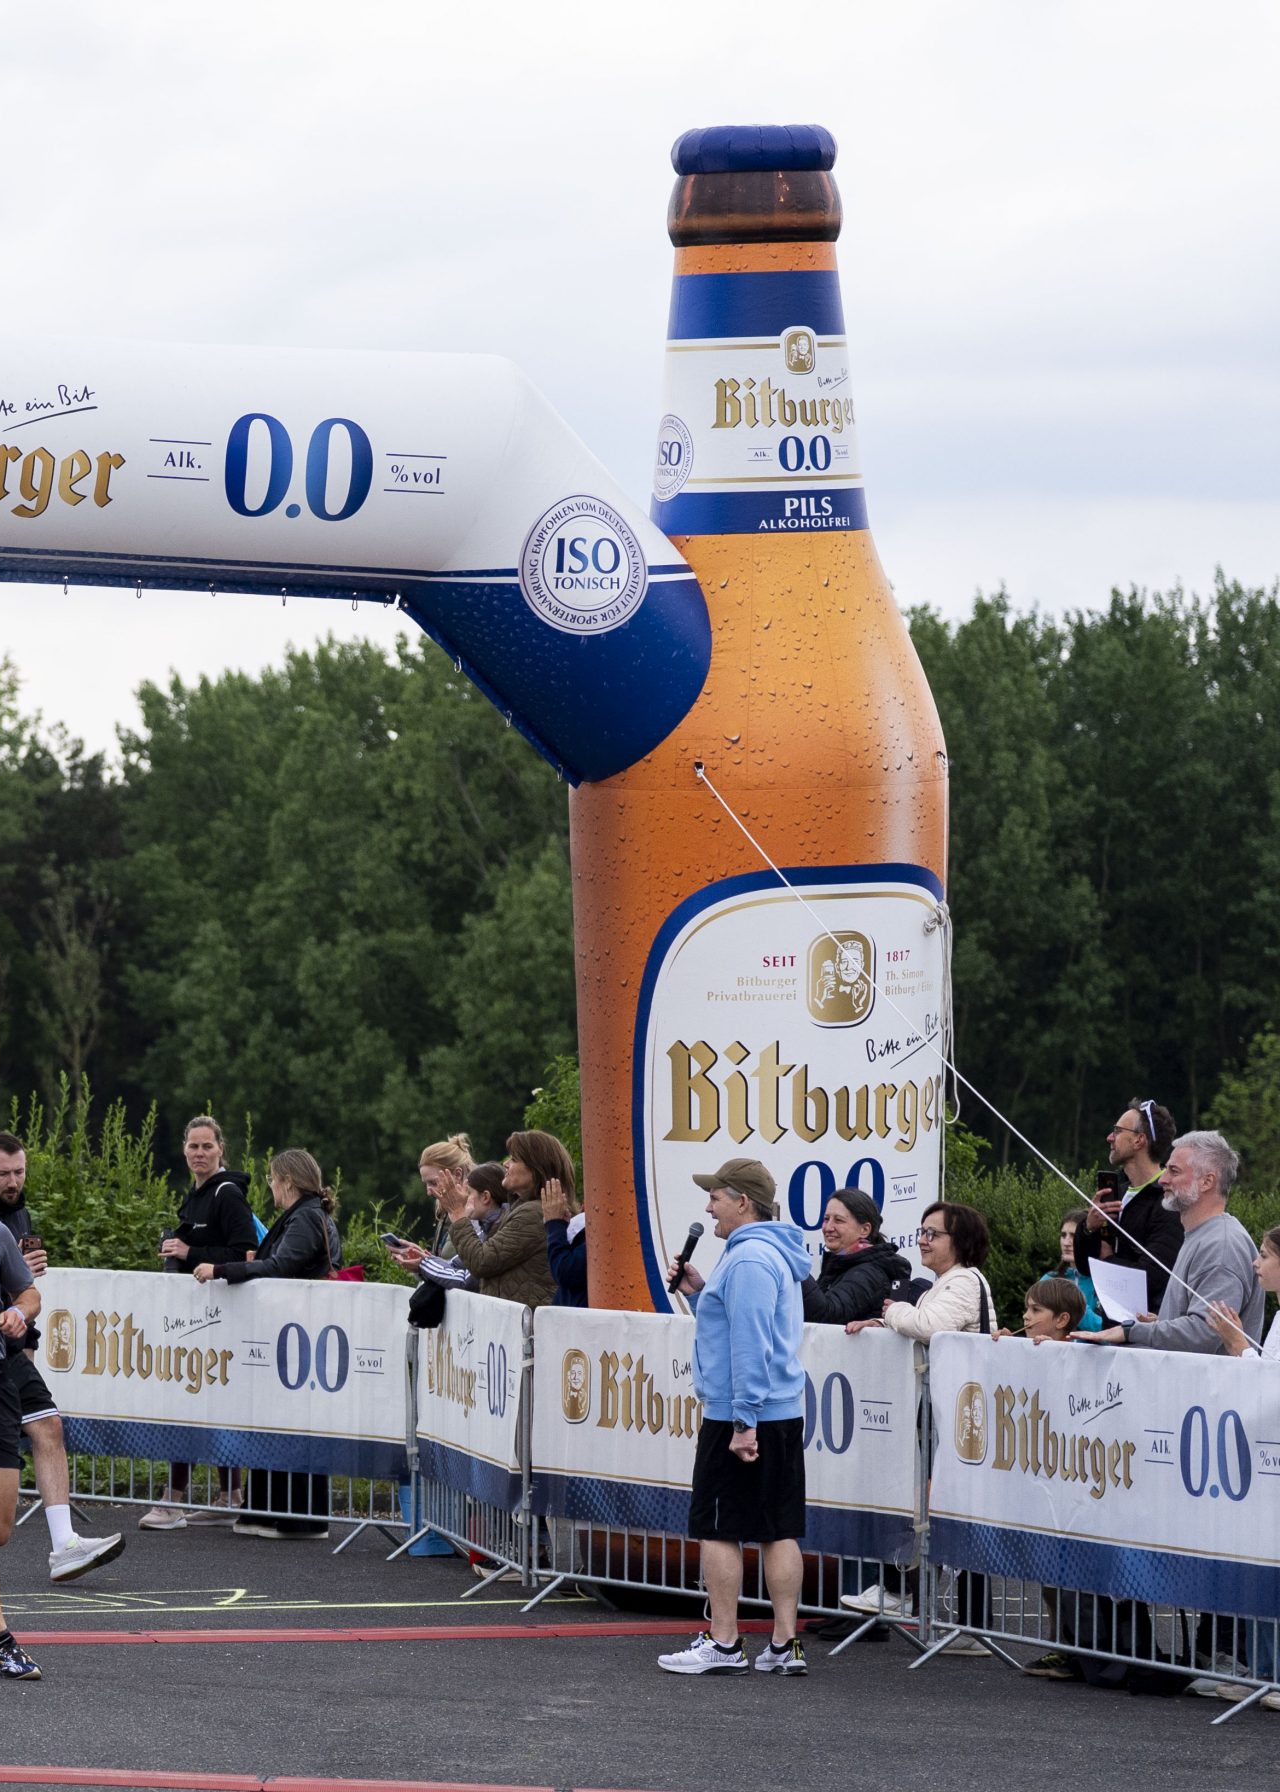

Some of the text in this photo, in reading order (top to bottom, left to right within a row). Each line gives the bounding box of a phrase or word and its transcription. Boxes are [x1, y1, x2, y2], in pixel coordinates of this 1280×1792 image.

[25, 397, 54, 412] ein
[58, 384, 95, 406] Bit
[711, 377, 856, 434] Bitburger
[164, 451, 202, 469] Alk.
[225, 412, 373, 522] 0.0
[778, 435, 832, 472] 0.0
[784, 496, 833, 517] PILS
[758, 516, 850, 530] ALKOHOLFREI
[529, 502, 640, 625] EMPFOHLEN VOM DEUTSCHEN INSTITUT FÜR SPORTERNÄHRUNG
[555, 537, 620, 574] ISO
[553, 577, 620, 590] TONISCH
[762, 955, 797, 968] SEIT
[886, 950, 910, 963] 1817
[736, 975, 797, 990] Bitburger
[902, 969, 924, 980] Simon
[707, 989, 797, 1002] Privatbrauerei
[885, 985, 915, 997] Bitburg
[866, 1038, 901, 1063] Bitte
[663, 1039, 942, 1153] Bitburger
[163, 1316, 186, 1332] Bitte
[81, 1310, 234, 1394] Bitburger
[249, 1348, 266, 1359] Alk.
[277, 1322, 350, 1393] 0.0
[488, 1341, 507, 1418] 0.0
[673, 1358, 692, 1379] Bitt
[596, 1350, 704, 1440] Bitbur
[1069, 1394, 1091, 1416] Bitte
[1106, 1381, 1123, 1402] Bit
[991, 1384, 1137, 1500] Bitburger
[1180, 1406, 1252, 1501] 0.0
